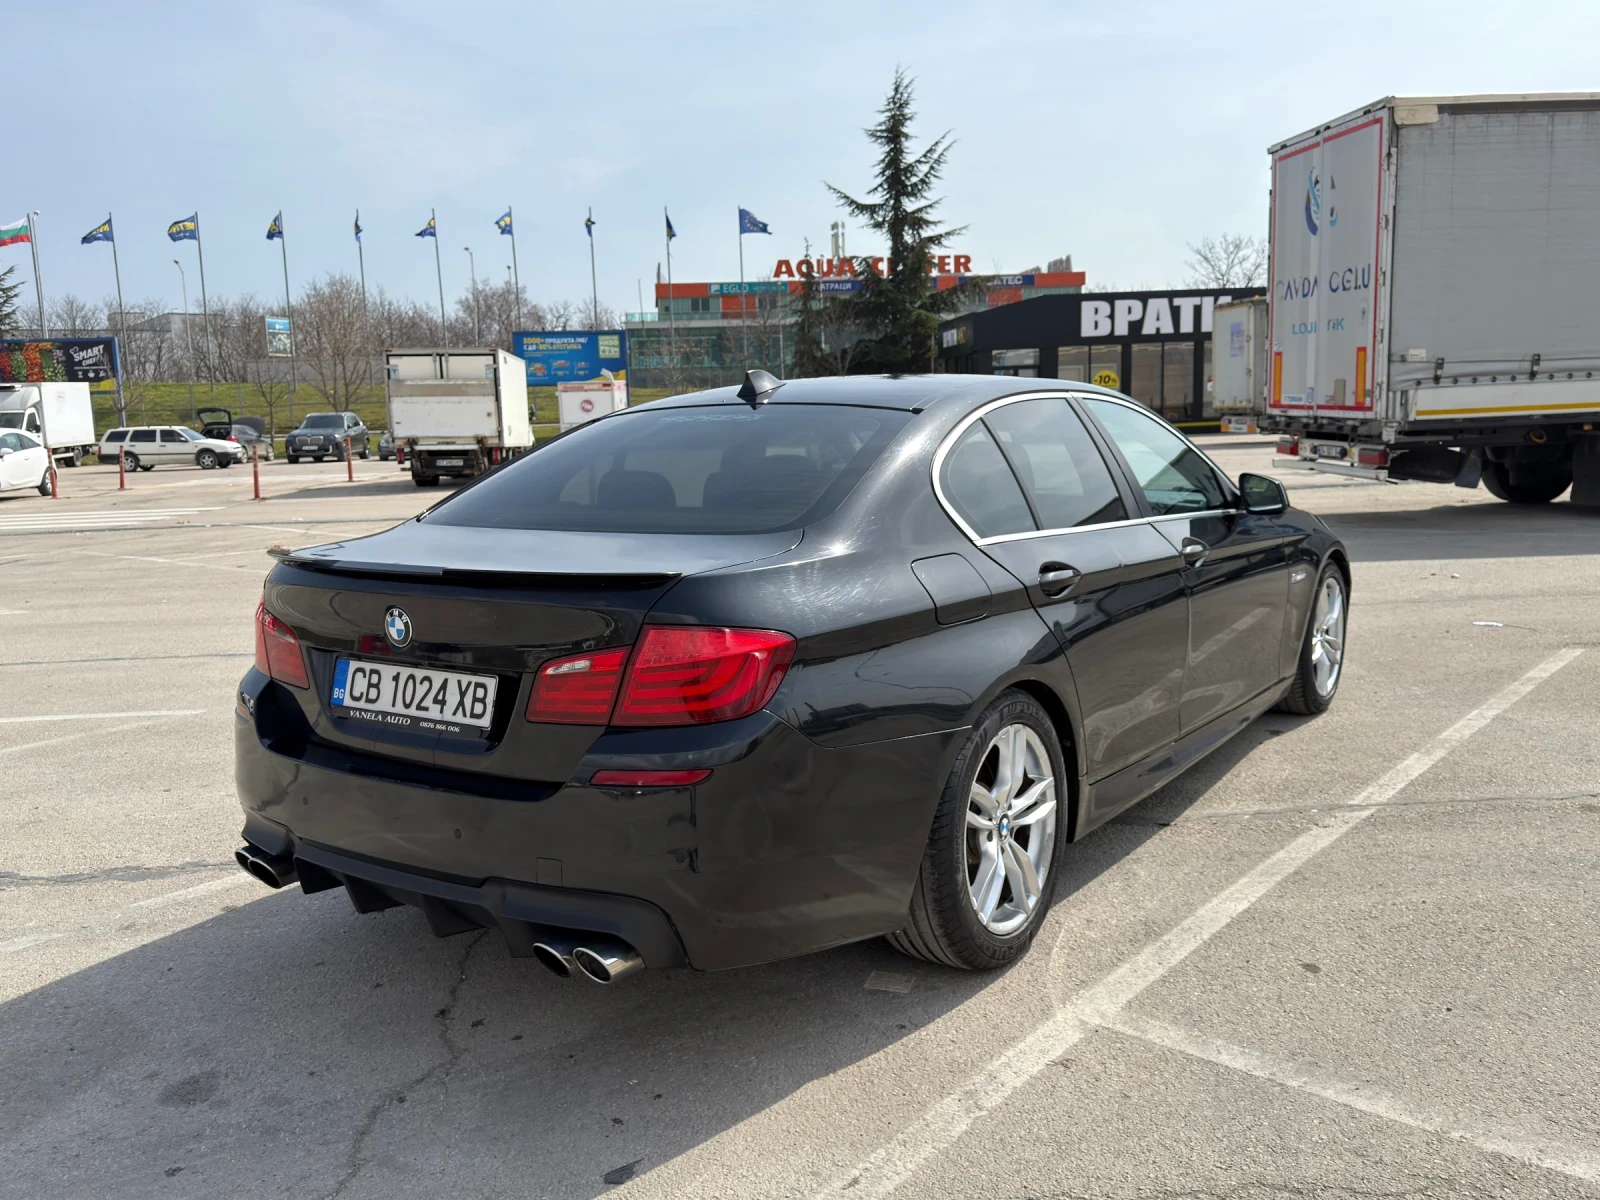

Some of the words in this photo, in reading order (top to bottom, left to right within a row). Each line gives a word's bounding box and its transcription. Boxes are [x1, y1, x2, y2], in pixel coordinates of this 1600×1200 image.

[773, 258, 857, 278] AQUA
[871, 254, 972, 276] CTER
[723, 283, 749, 294] EGLO
[74, 345, 104, 362] SMART
[1094, 374, 1117, 385] -10%
[386, 609, 408, 623] BMW
[333, 687, 345, 699] BG
[350, 666, 382, 704] CB
[391, 671, 449, 715] 1024
[451, 679, 488, 720] XB
[350, 710, 382, 722] VANELA
[384, 715, 411, 726] AUTO
[419, 721, 435, 729] 0876
